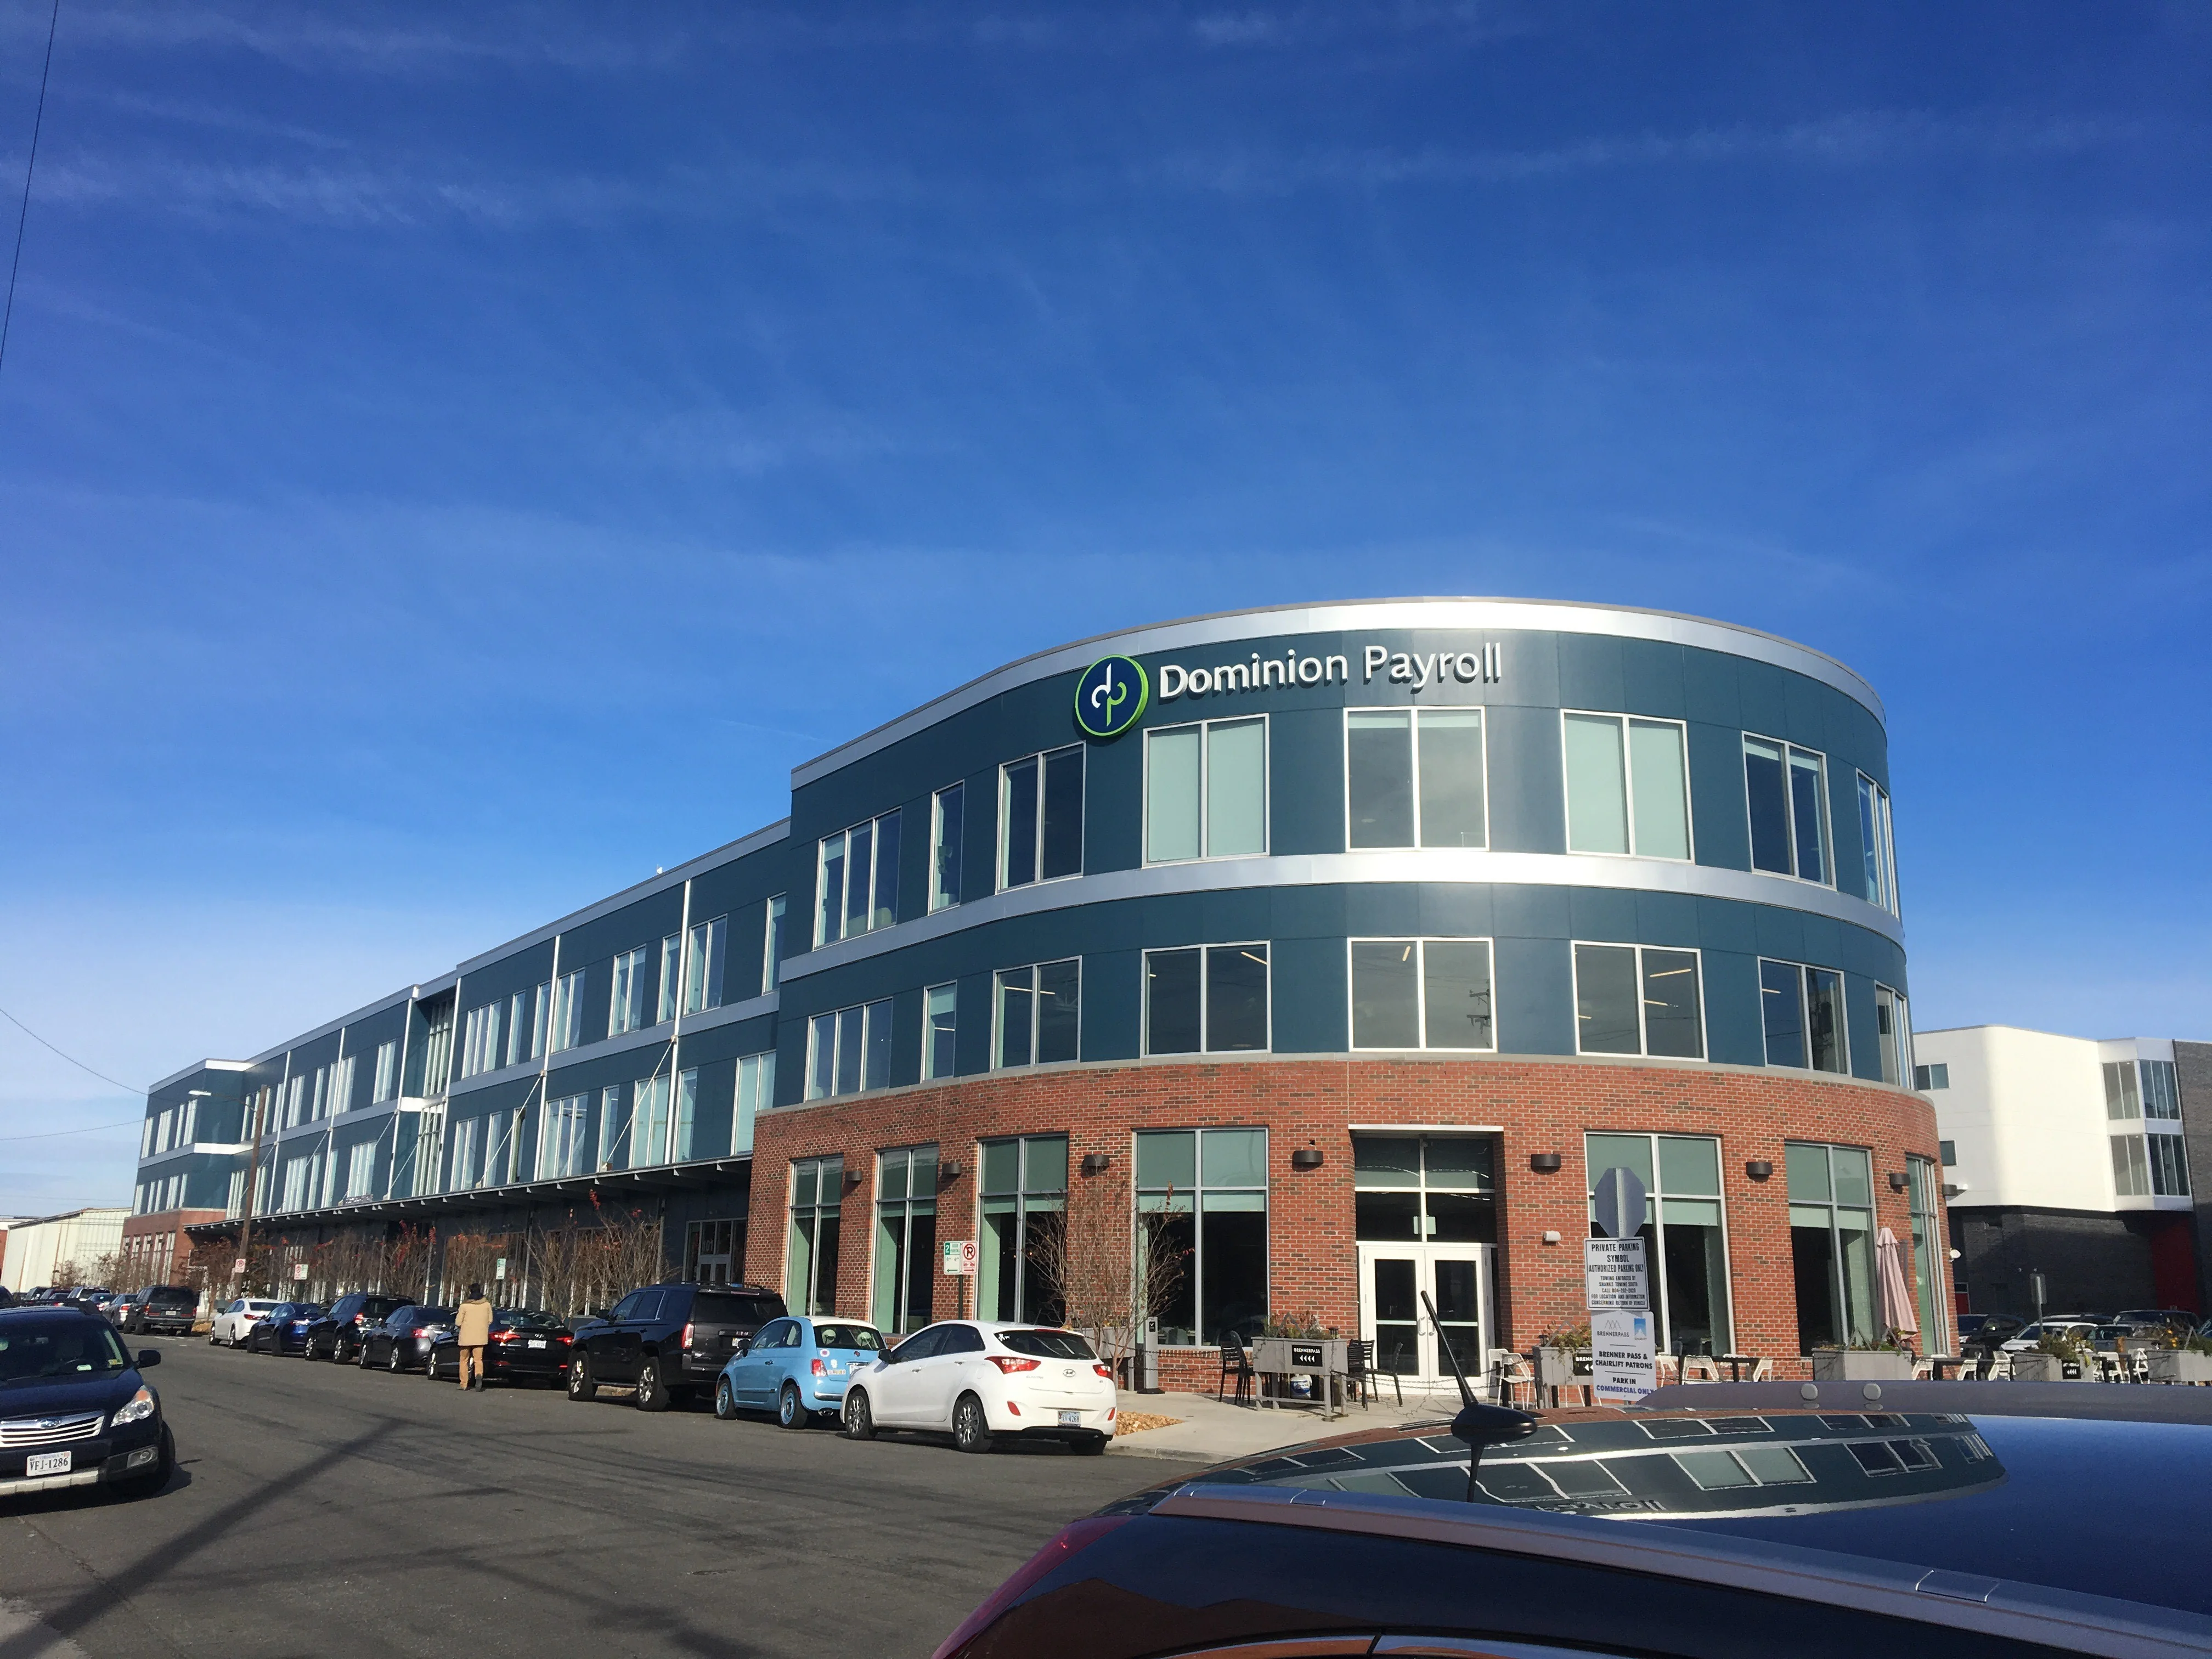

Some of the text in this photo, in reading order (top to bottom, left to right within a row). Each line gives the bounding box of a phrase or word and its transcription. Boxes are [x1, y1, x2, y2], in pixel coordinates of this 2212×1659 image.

[1160, 642, 1502, 699] Dominion Payroll
[945, 1244, 950, 1253] 2
[1618, 1243, 1640, 1251] PARKING
[1607, 1254, 1629, 1262] SYMBOL
[1618, 1264, 1634, 1272] PARKING
[1635, 1263, 1644, 1272] ONLY
[1596, 1385, 1637, 1394] COMMERCIAL
[30, 1457, 69, 1471] VFJ-1286
